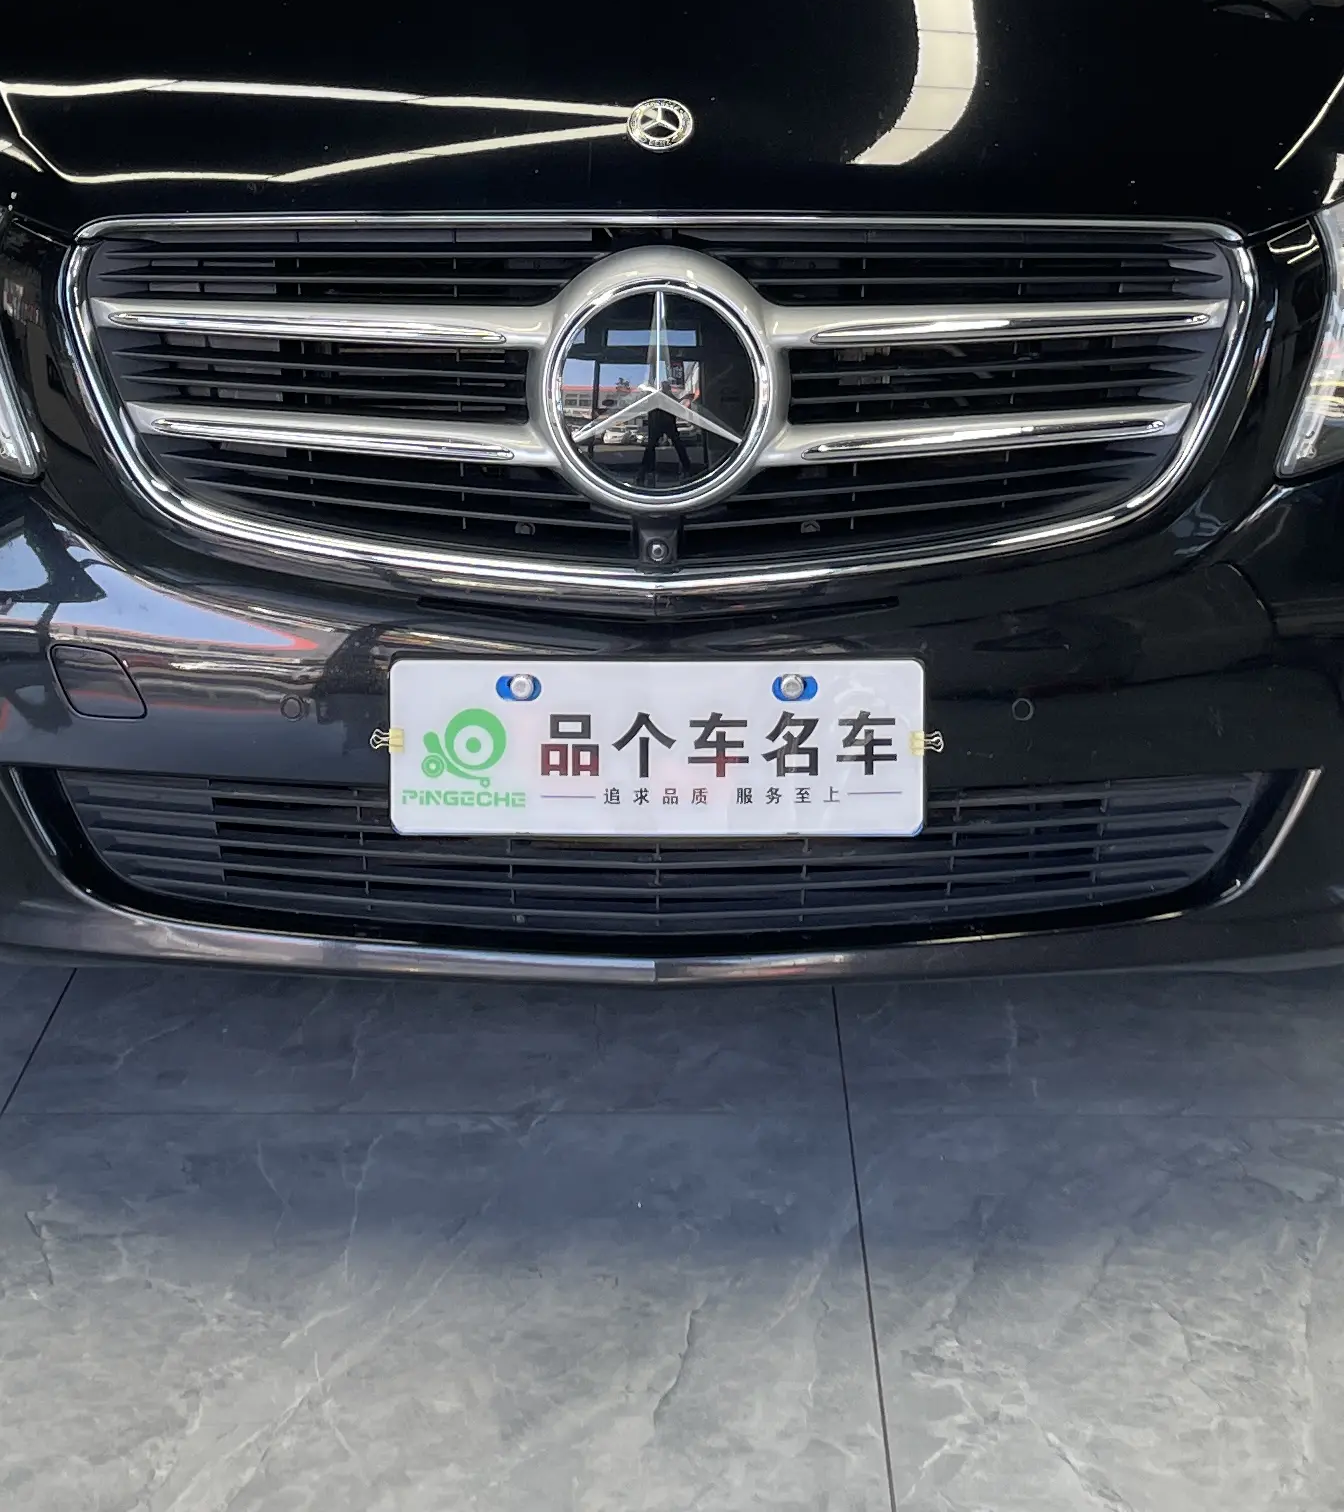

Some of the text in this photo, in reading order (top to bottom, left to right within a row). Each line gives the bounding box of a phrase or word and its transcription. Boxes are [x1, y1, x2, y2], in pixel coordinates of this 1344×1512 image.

[540, 710, 897, 778] 品个车名车
[603, 787, 841, 805] 追求品质 服务至上
